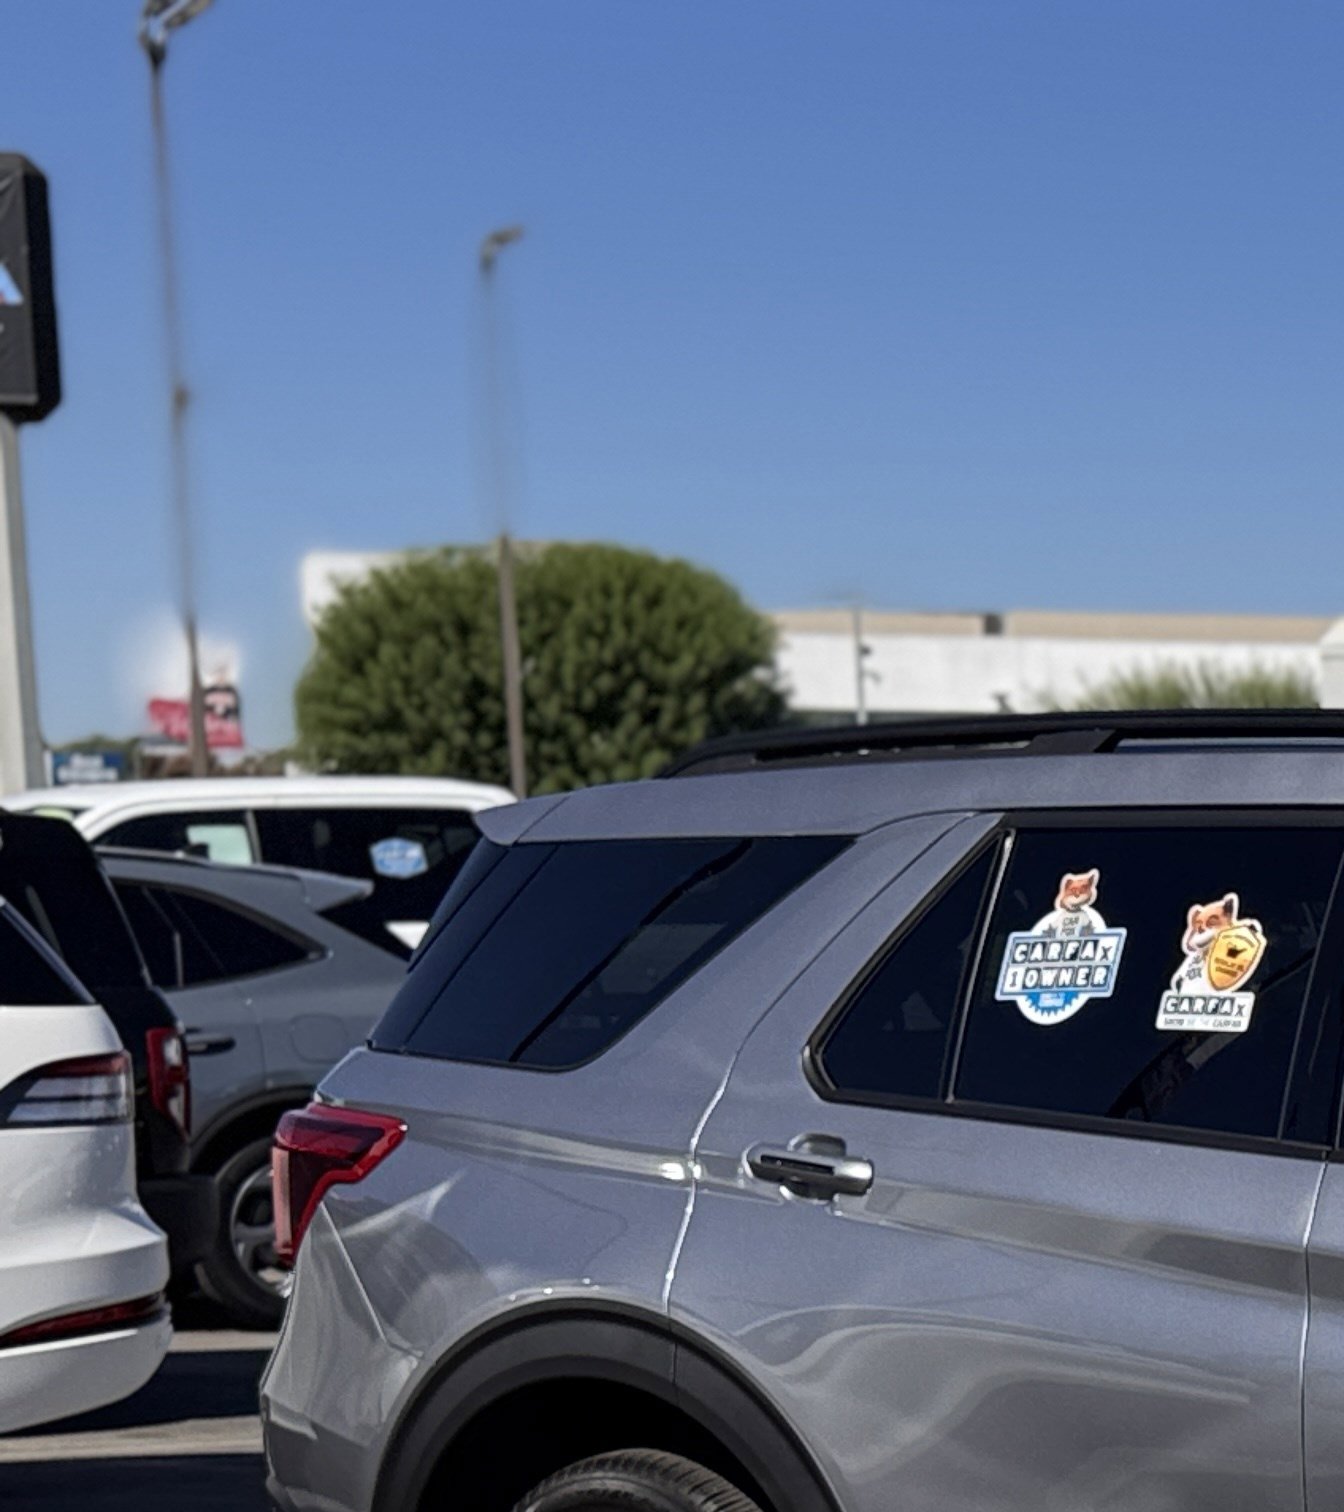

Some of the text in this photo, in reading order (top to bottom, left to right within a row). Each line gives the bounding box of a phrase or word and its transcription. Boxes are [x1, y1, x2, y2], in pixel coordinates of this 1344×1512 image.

[1013, 938, 1113, 963] CARFAX
[1009, 965, 1110, 989] 1 OWNER
[1164, 996, 1246, 1017] CARFAX
